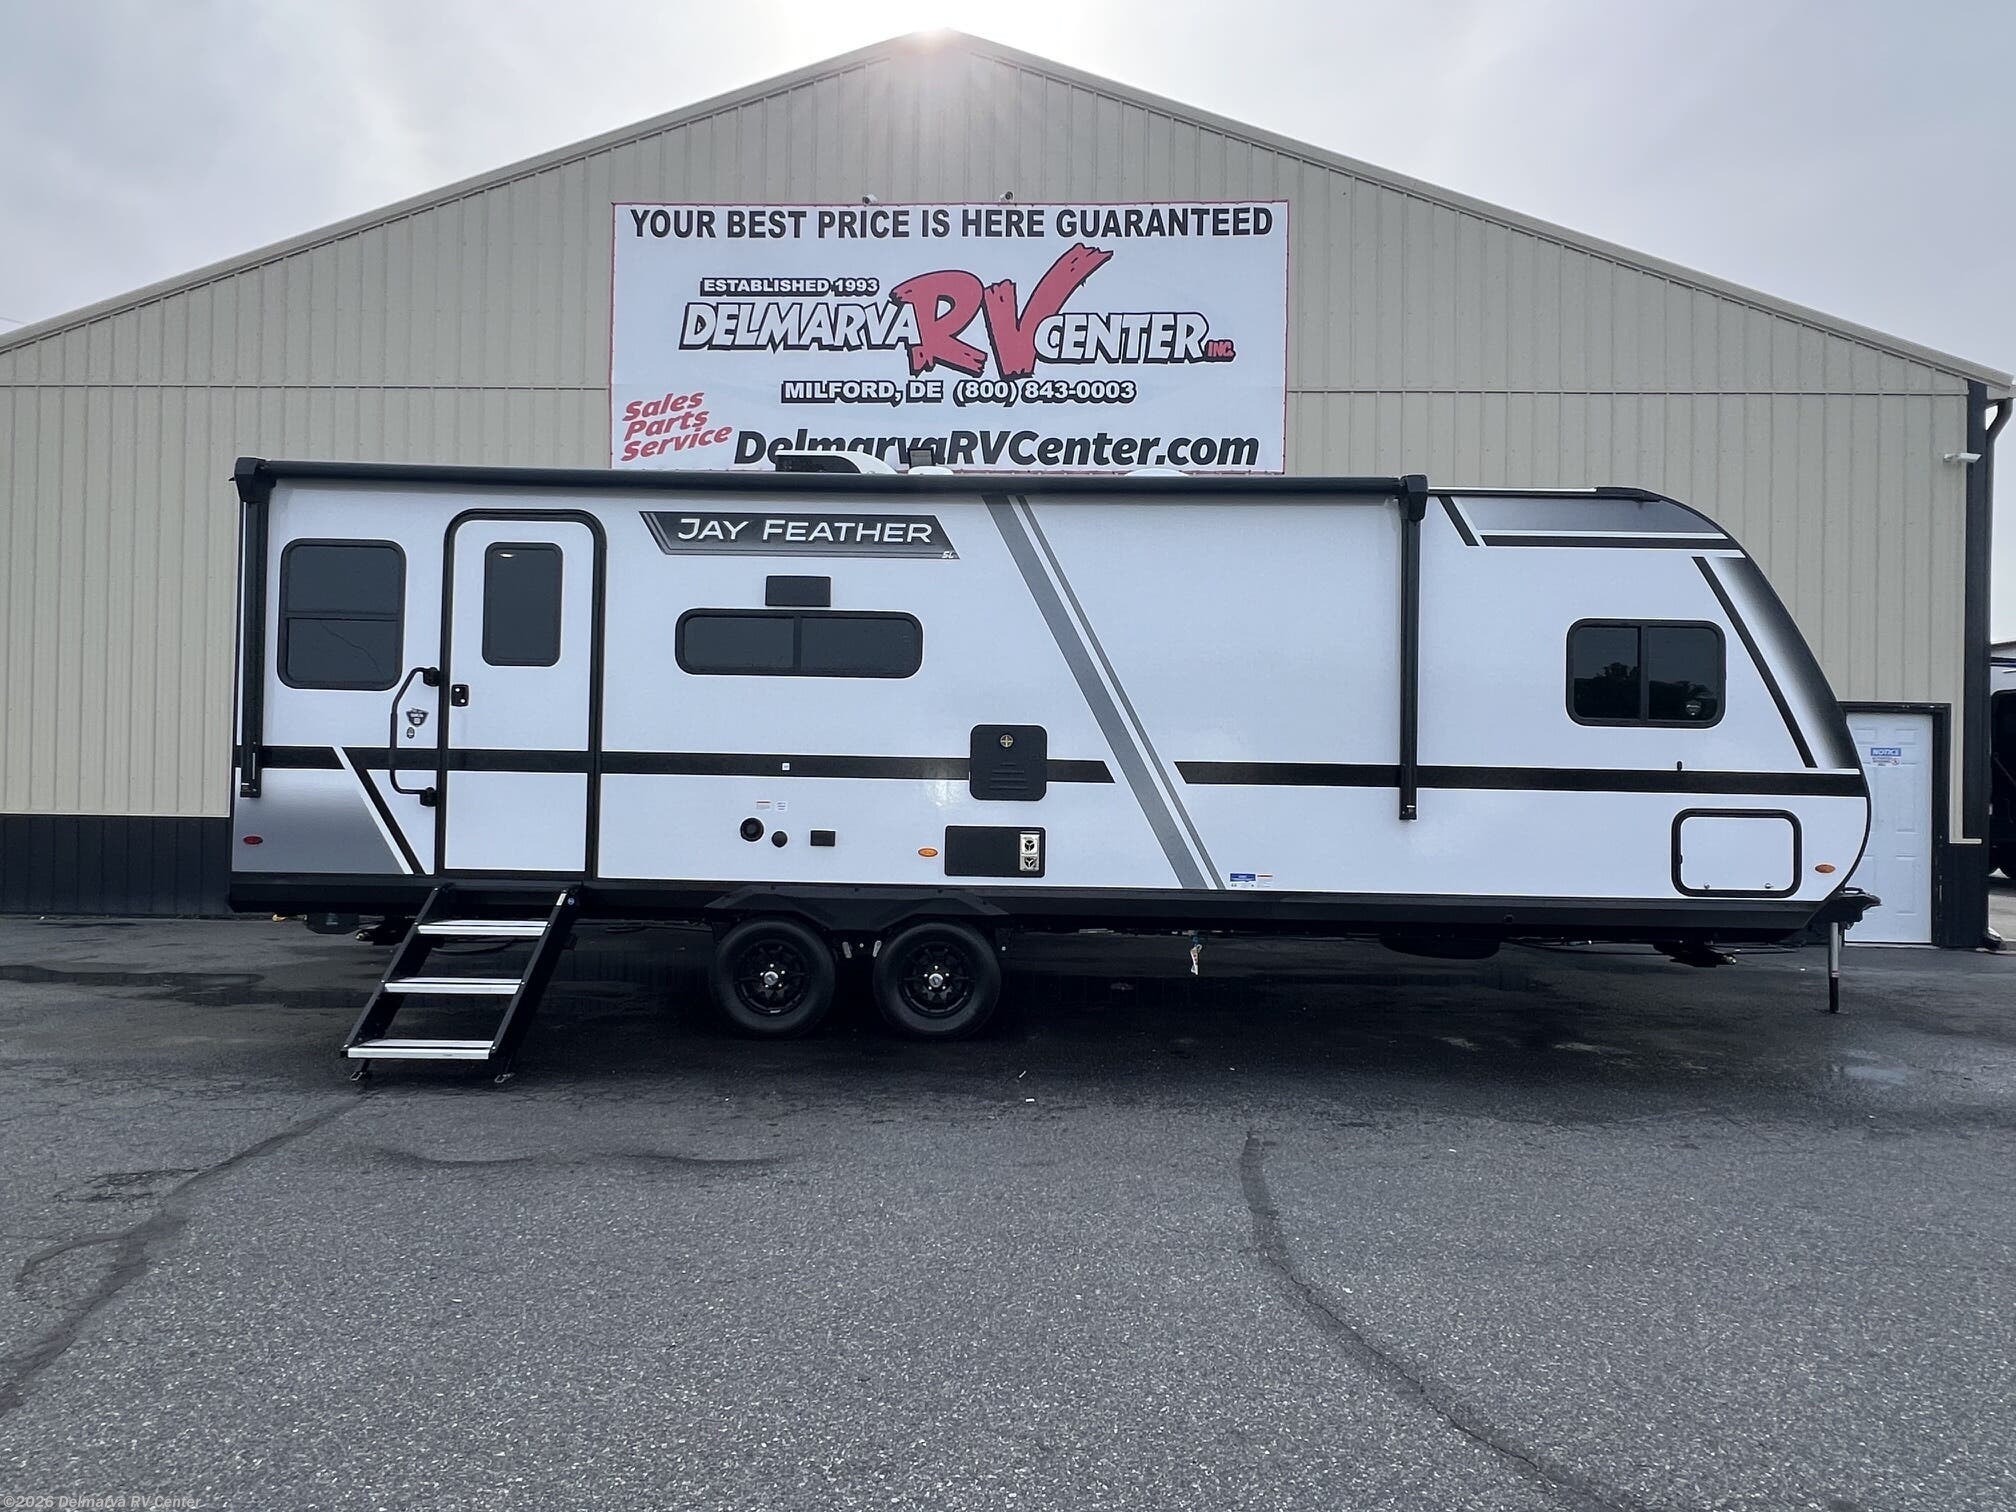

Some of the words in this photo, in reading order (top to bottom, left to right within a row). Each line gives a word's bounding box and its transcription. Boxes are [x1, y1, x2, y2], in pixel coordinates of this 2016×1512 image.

[631, 209, 716, 238] YOUR
[727, 210, 806, 238] BEST
[818, 210, 910, 238] PRICE
[921, 209, 950, 237] IS
[961, 209, 1045, 237] HERE
[1056, 208, 1273, 237] GUARANTEED
[701, 278, 830, 295] ESTABLISHED
[834, 278, 880, 295] 1993
[679, 301, 923, 351] DELMARVA
[889, 243, 1114, 379] RV
[1034, 313, 1210, 363] CENTER
[622, 393, 704, 421] Sales
[782, 381, 903, 405] MILFORD,
[907, 381, 943, 402] DE
[953, 381, 1018, 406] (800)
[1022, 381, 1136, 402] 843-0003
[624, 411, 709, 441] Parts
[621, 427, 733, 461] Service
[734, 429, 1259, 466] DelmarvaRVCenter.com
[678, 518, 749, 540] JAY
[762, 519, 932, 543] FEATHER
